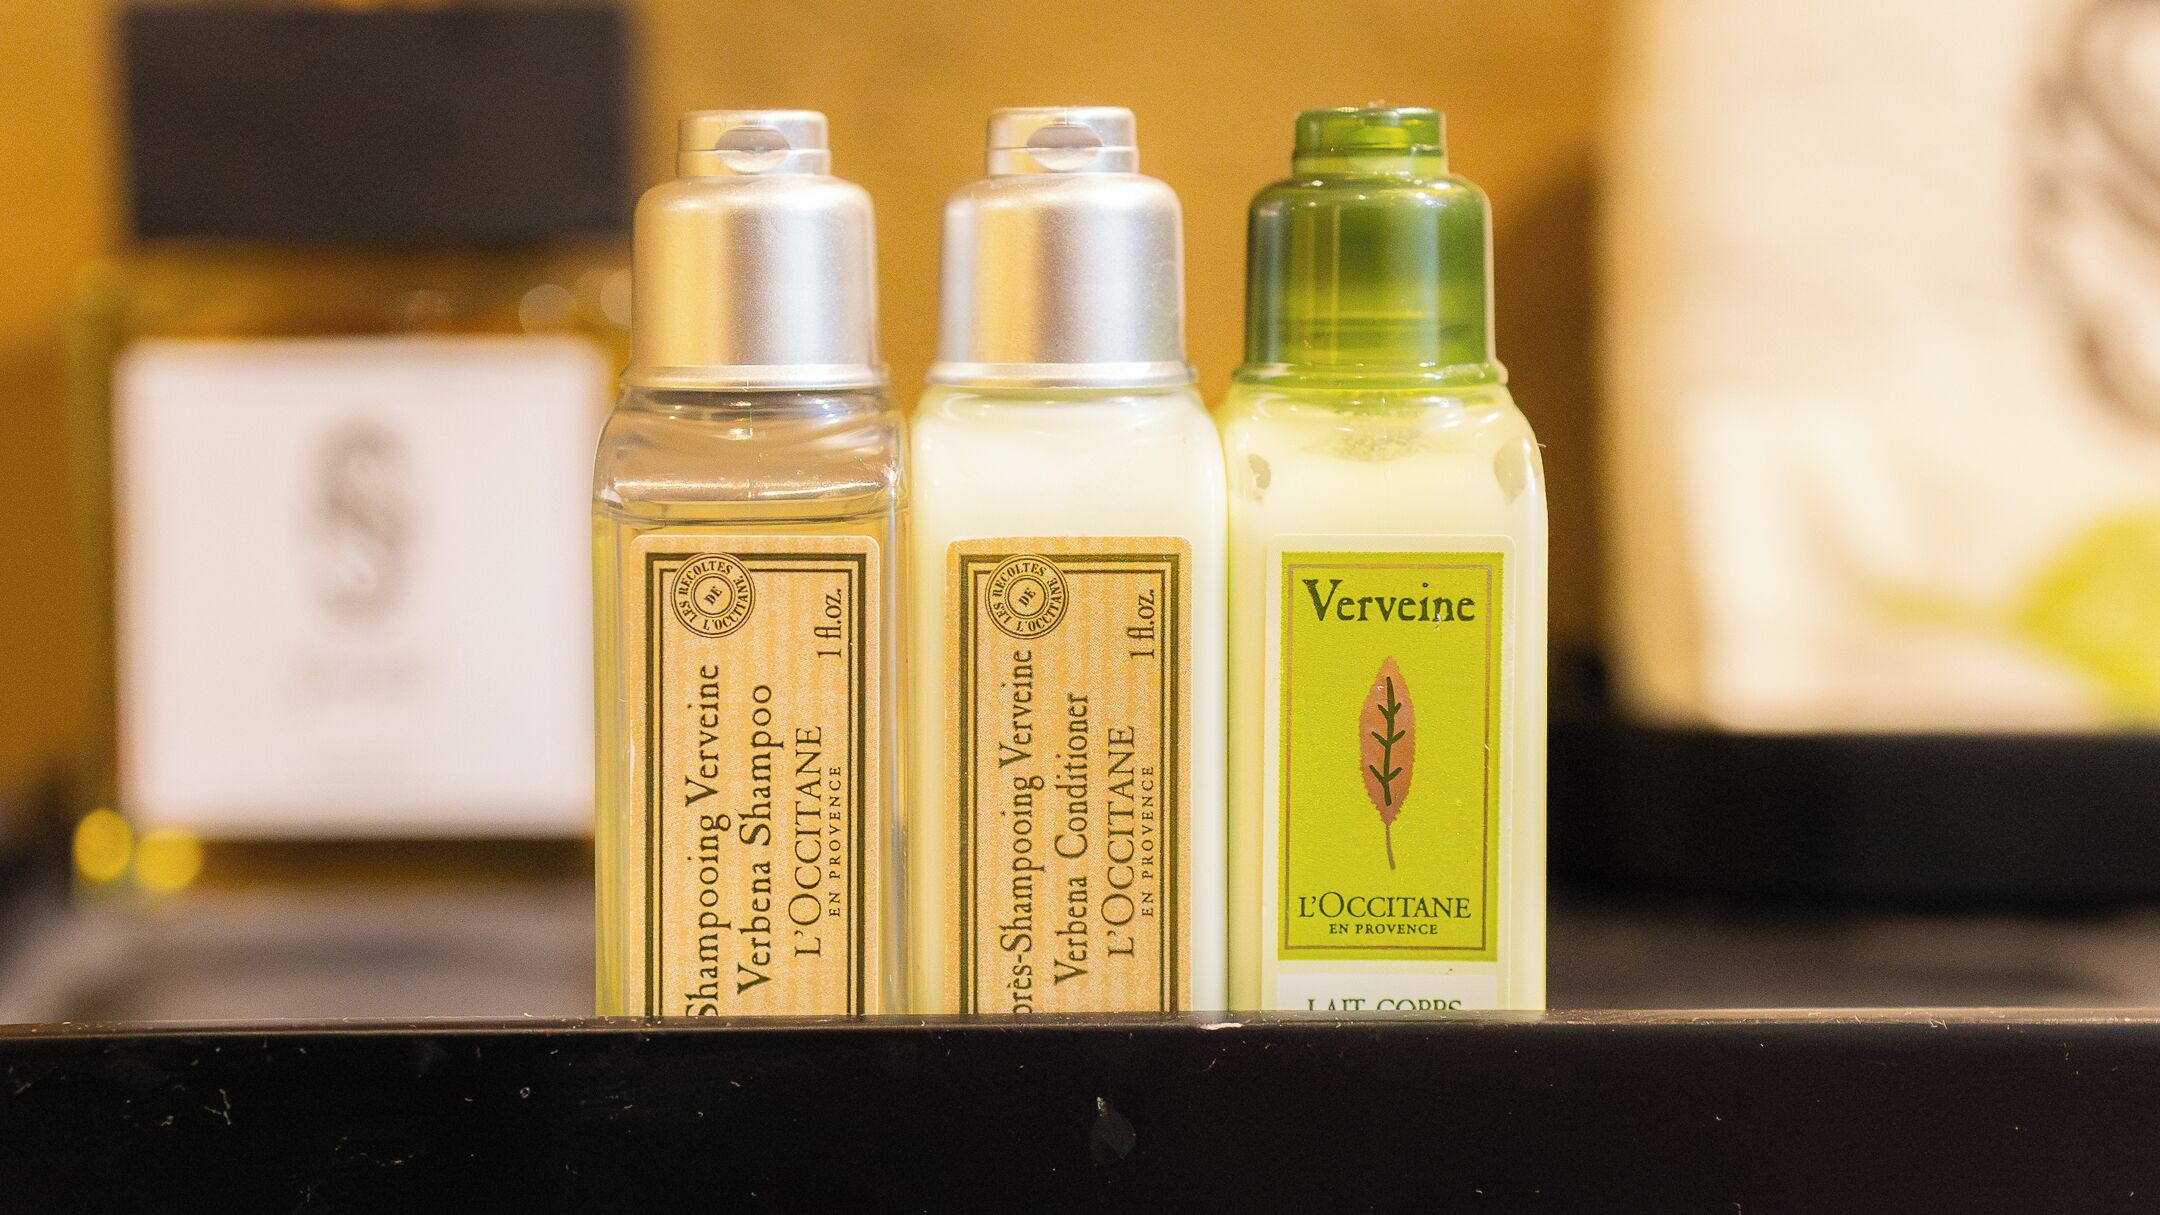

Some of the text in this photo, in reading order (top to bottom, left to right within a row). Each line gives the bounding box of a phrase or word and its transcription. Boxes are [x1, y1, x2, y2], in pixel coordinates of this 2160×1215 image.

[678, 599, 698, 623] LES
[703, 575, 749, 631] L'OCCITANE
[704, 585, 722, 606] DE
[993, 601, 1012, 624] LES
[1015, 577, 1062, 632] L'OCCITANE
[1018, 586, 1037, 607] DE
[1302, 577, 1476, 624] Verveine
[817, 648, 842, 660] 1
[1130, 648, 1155, 660] 1
[998, 649, 1033, 769] Verveine
[685, 664, 731, 1017] Shampooing Verveine
[736, 684, 784, 995] Verbena Shampoo
[788, 725, 822, 957] L'OCCITANE
[828, 765, 842, 917] EN PROVENCE
[1053, 691, 1089, 984] Verbena Conditioner
[1101, 725, 1136, 957] L'OCCITANE
[1141, 765, 1154, 917] EN PROVENCE
[1299, 891, 1472, 920] L'OCCITANE
[1328, 923, 1439, 935] EN PROVENCE
